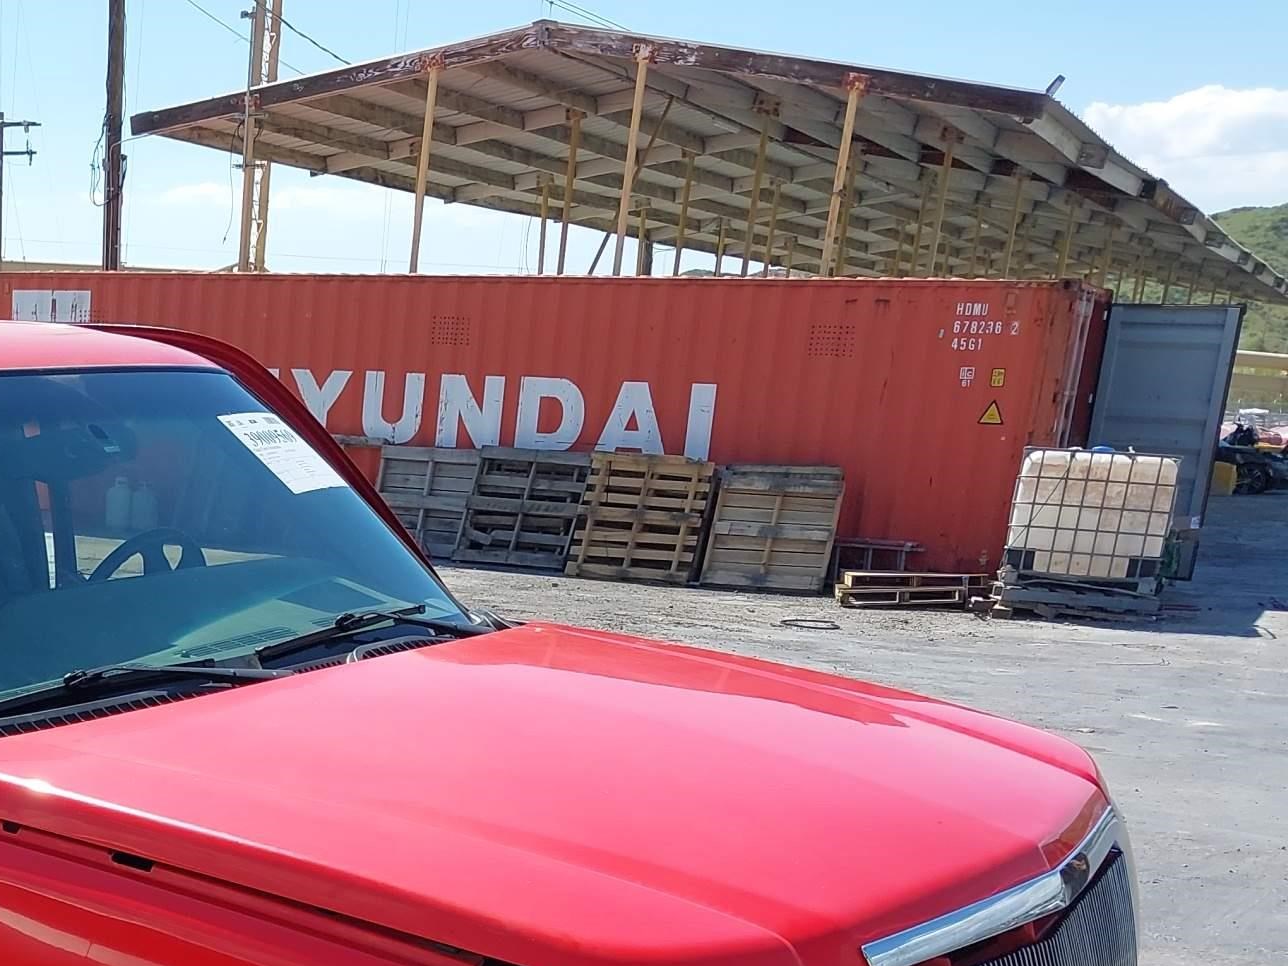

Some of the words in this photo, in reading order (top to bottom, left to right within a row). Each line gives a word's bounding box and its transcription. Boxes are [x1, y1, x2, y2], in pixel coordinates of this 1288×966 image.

[956, 302, 989, 316] HDMU
[953, 320, 1003, 335] 678236
[1010, 321, 1020, 336] 2
[951, 337, 983, 351] 45G1
[268, 367, 718, 463] YUNDAI
